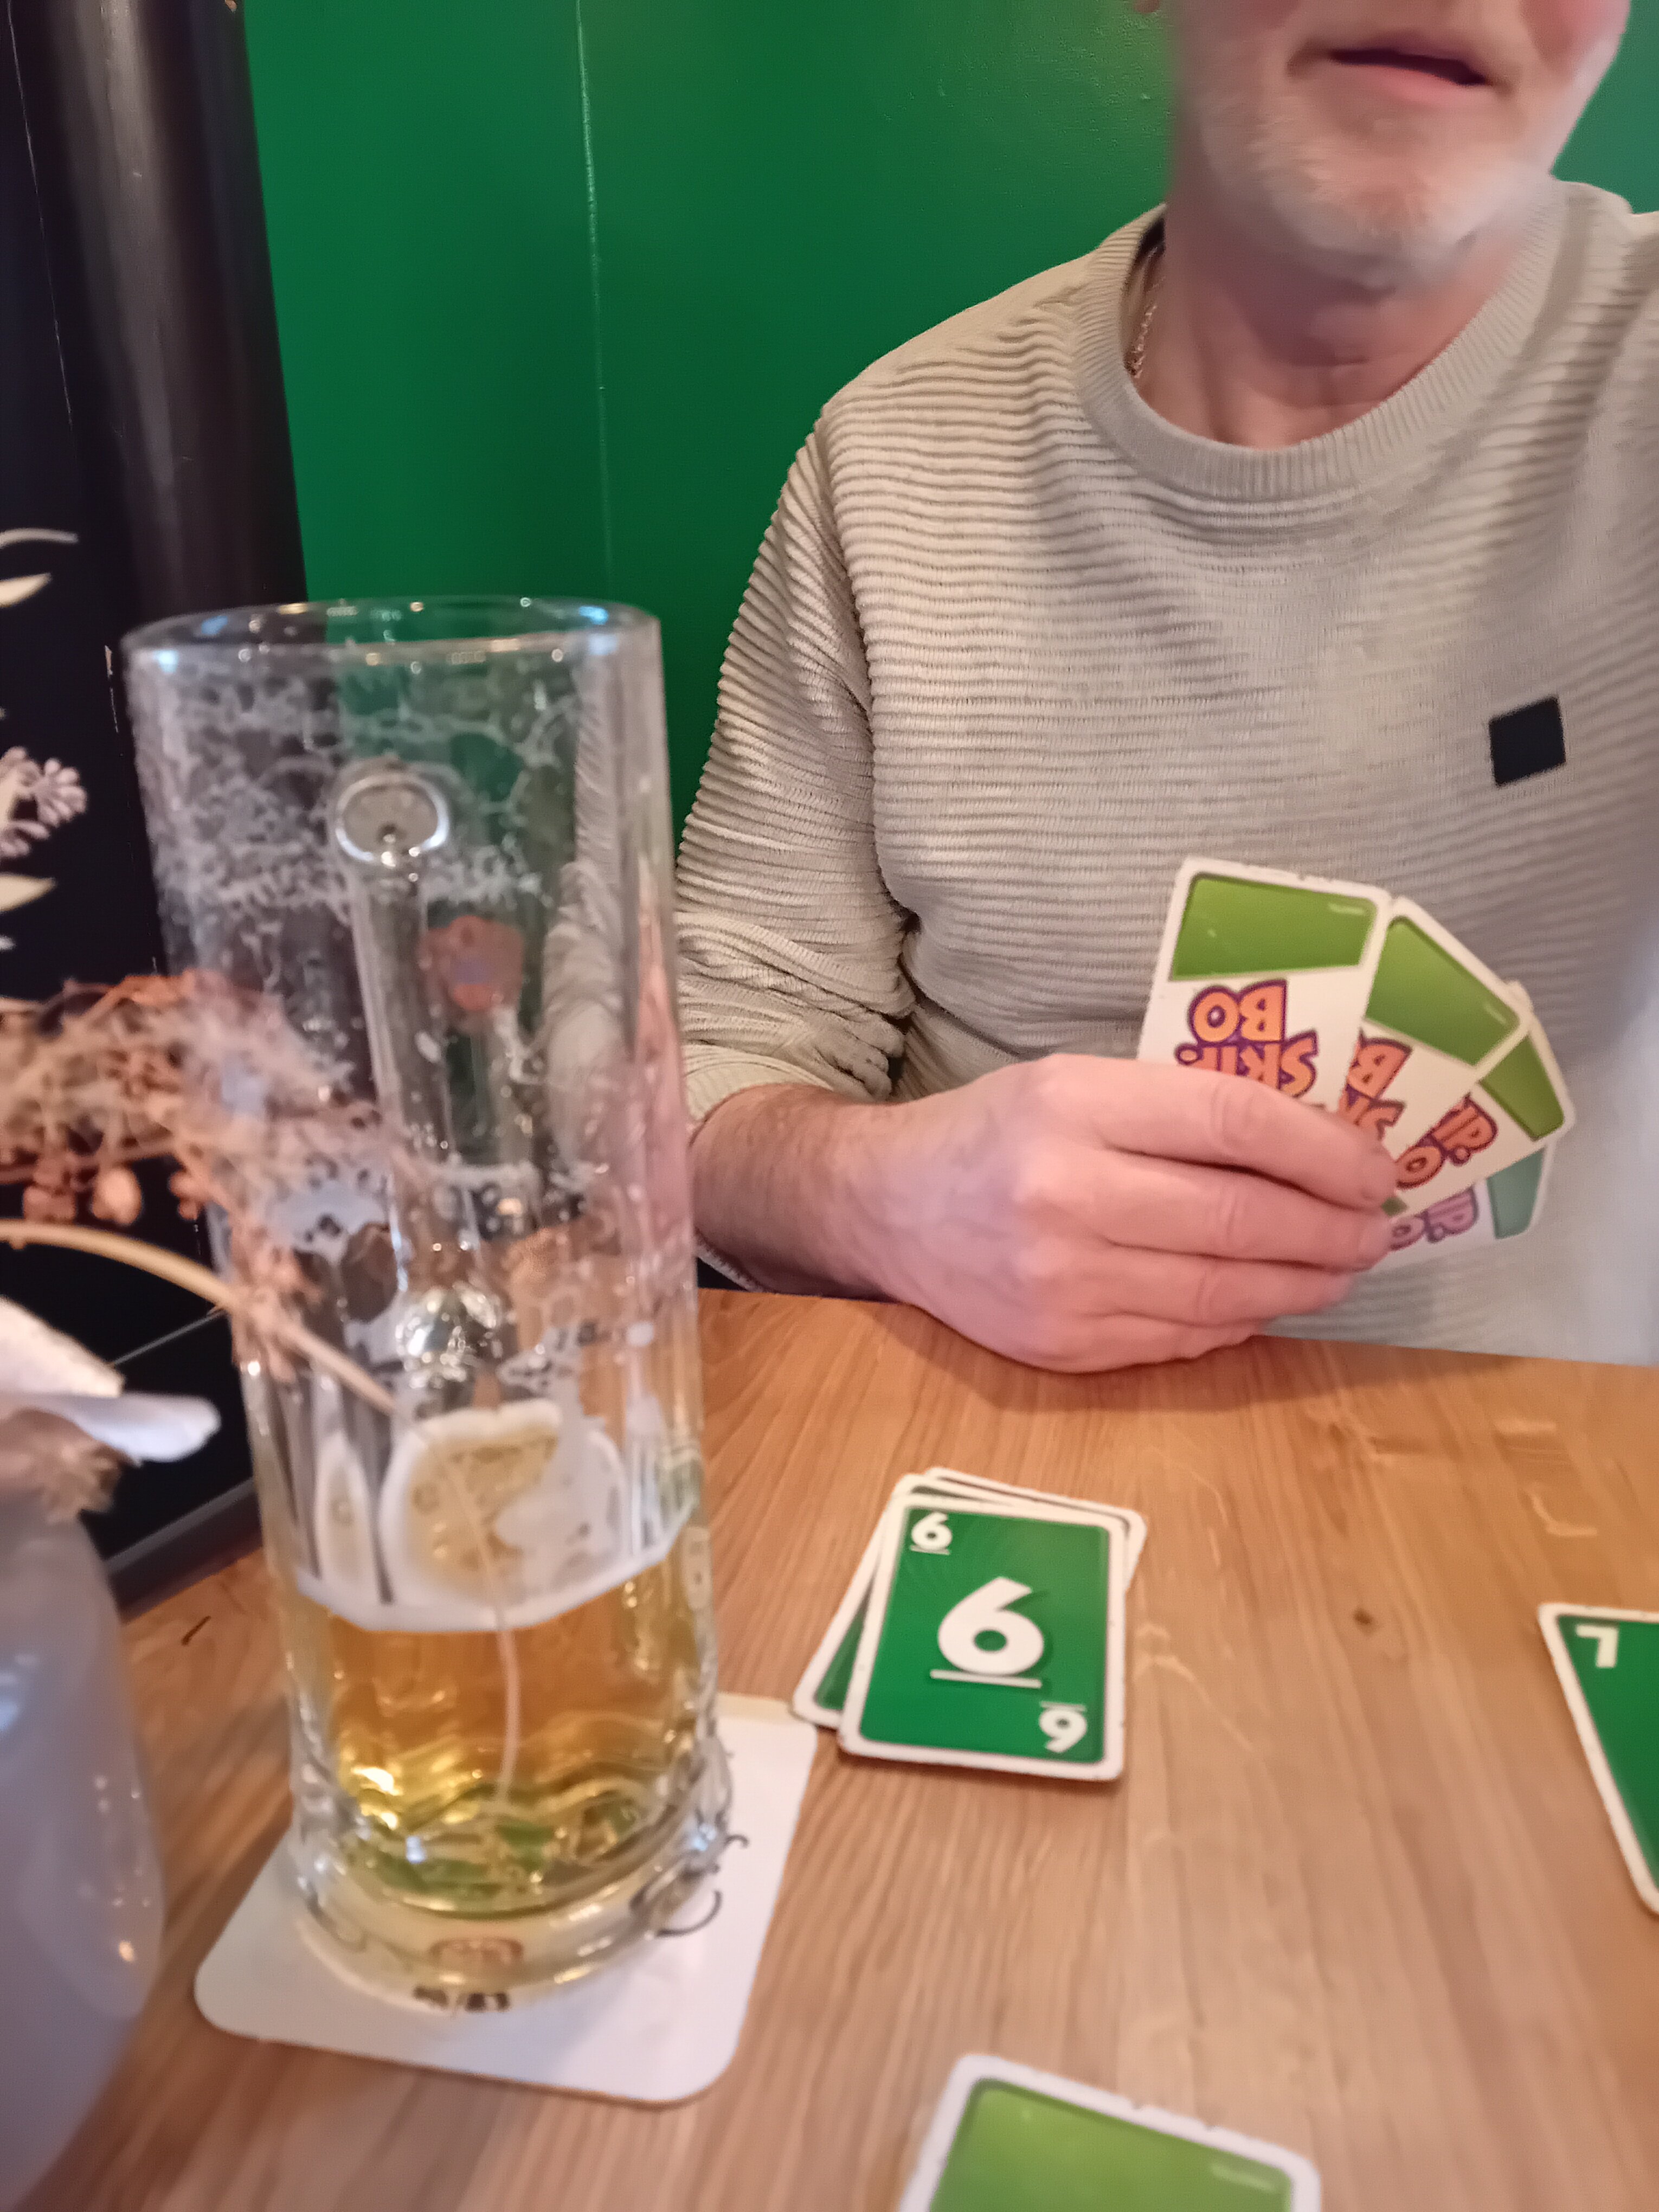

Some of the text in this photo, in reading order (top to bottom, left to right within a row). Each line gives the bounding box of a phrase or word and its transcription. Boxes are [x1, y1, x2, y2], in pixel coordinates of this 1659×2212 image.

[1187, 979, 1288, 1043] BO
[1348, 1027, 1413, 1100] B
[911, 1512, 953, 1552] 6
[937, 1576, 1044, 1676] 6
